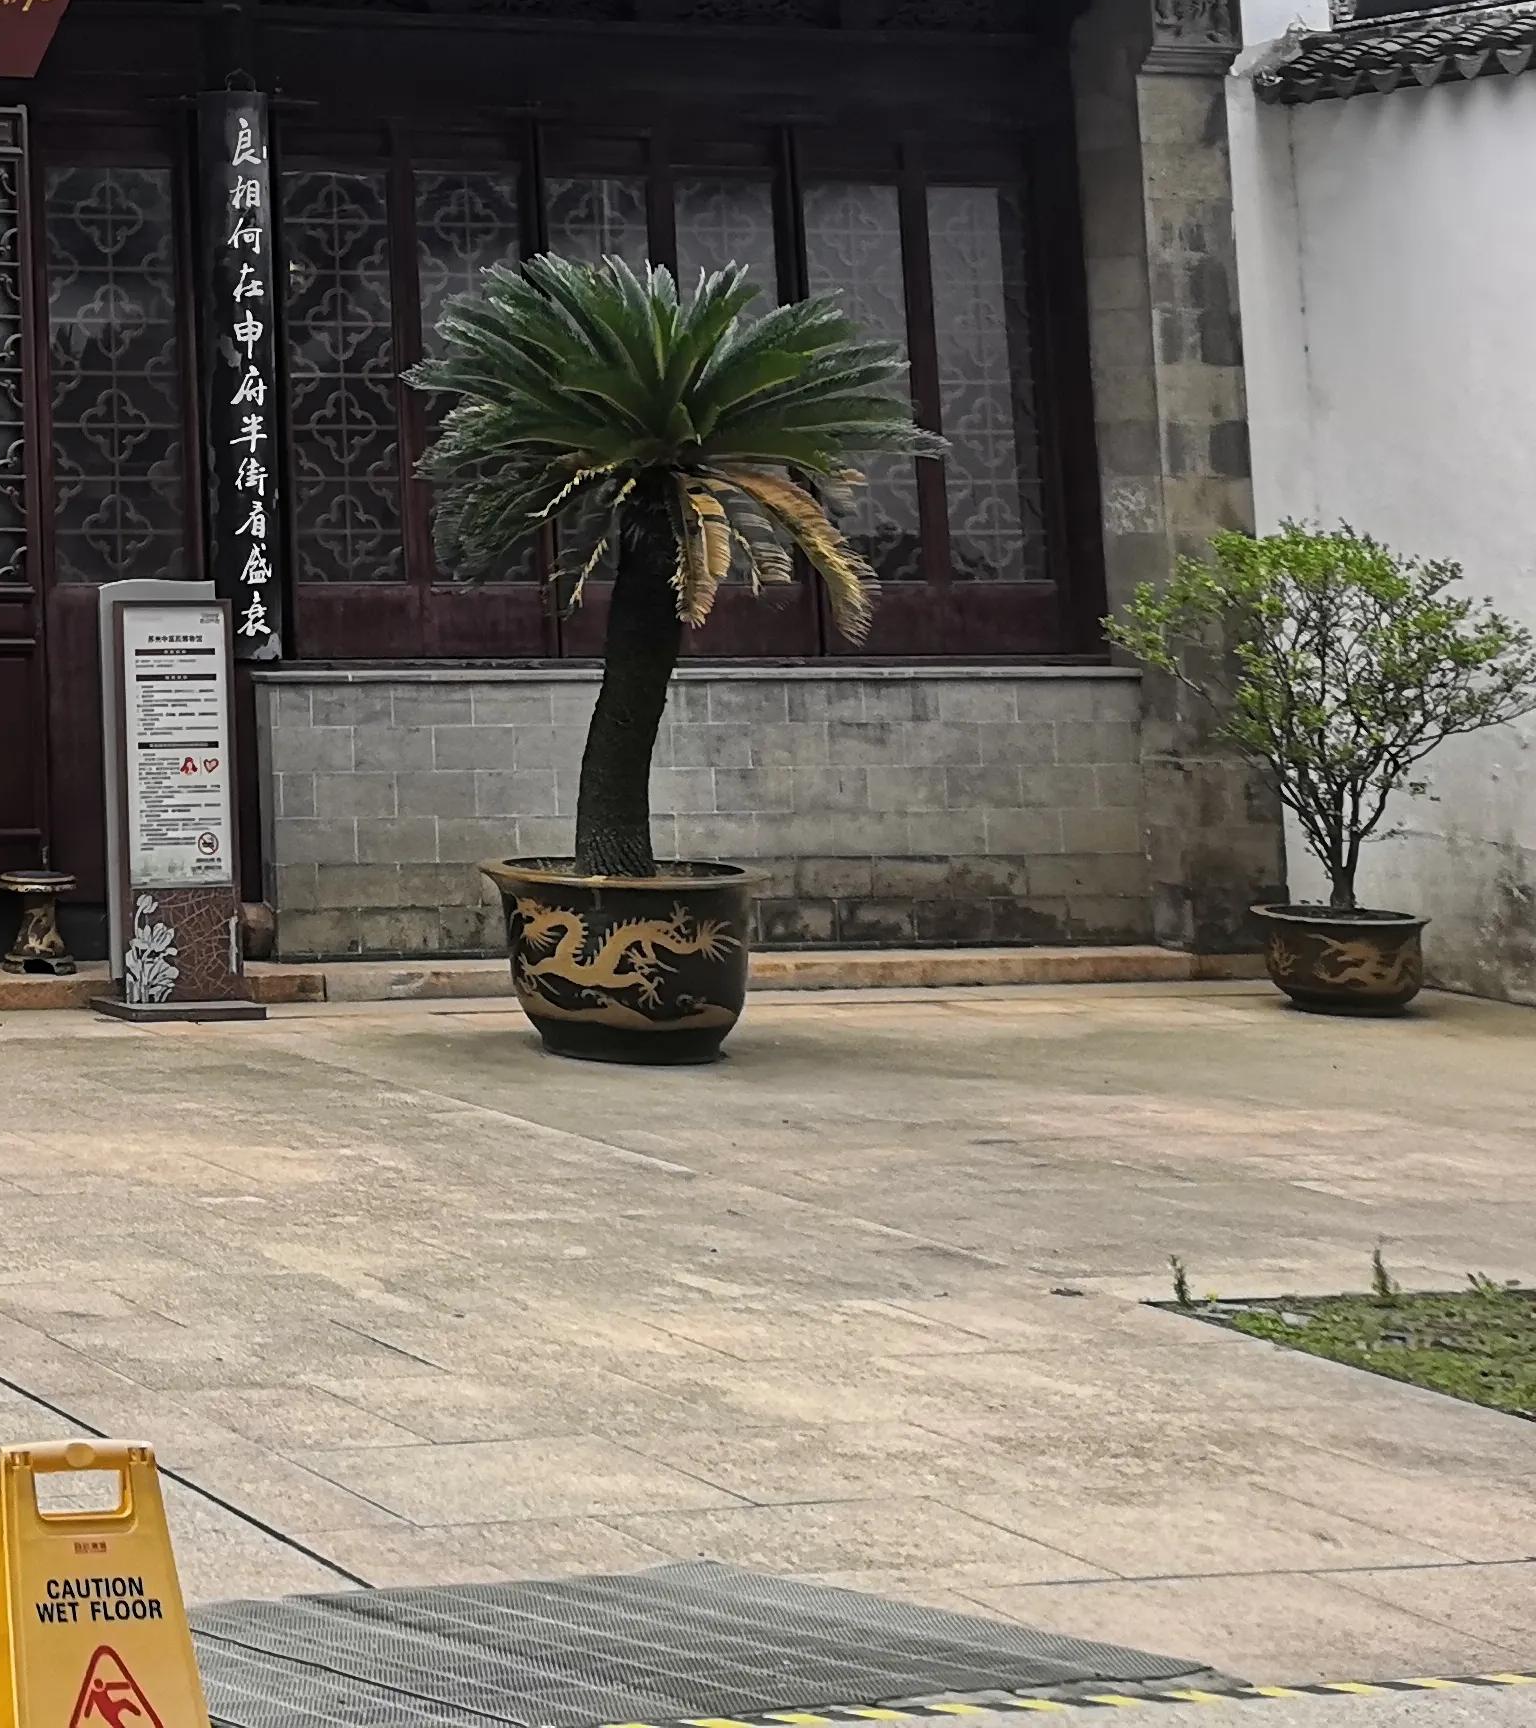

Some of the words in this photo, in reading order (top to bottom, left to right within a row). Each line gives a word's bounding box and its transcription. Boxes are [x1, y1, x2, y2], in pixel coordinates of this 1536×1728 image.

[46, 1576, 144, 1600] CAUTION
[36, 1602, 79, 1623] WET
[90, 1599, 163, 1622] FLOOR
